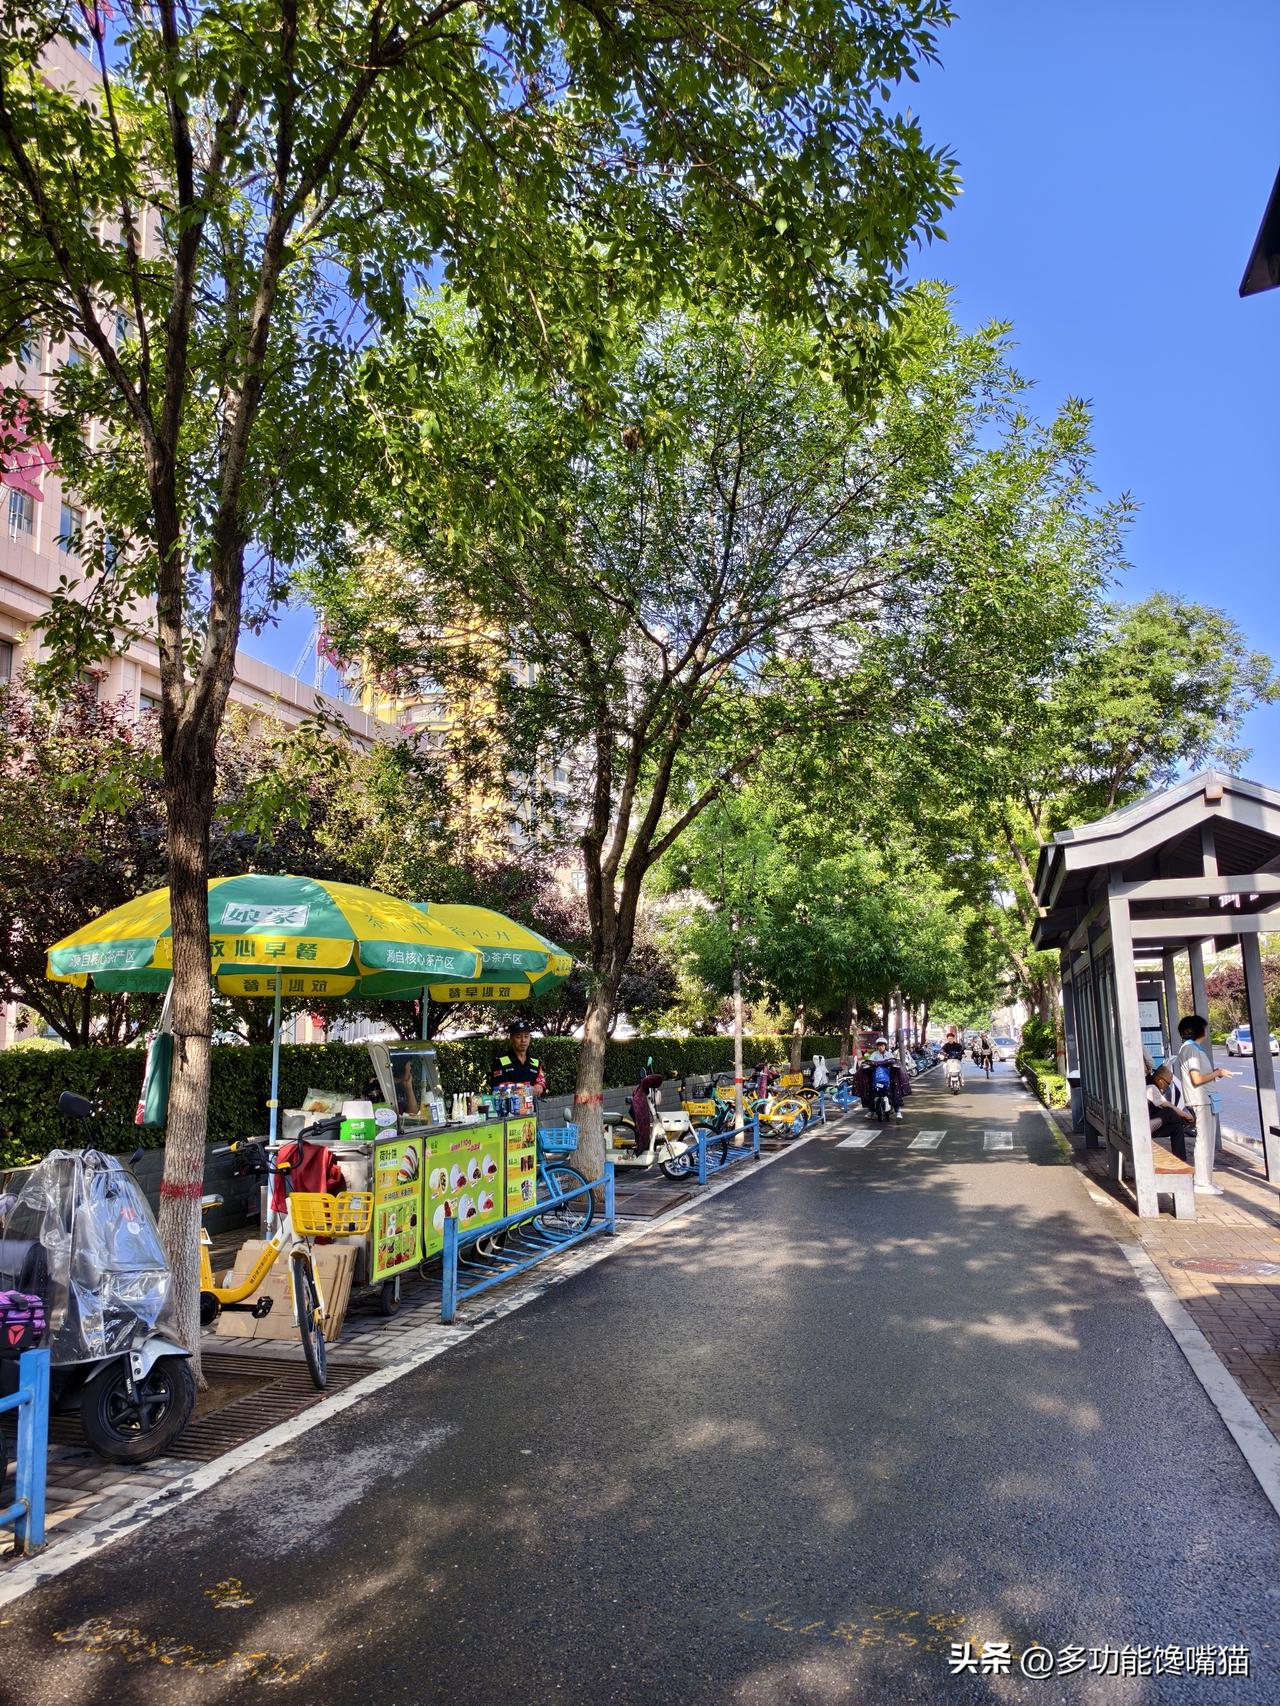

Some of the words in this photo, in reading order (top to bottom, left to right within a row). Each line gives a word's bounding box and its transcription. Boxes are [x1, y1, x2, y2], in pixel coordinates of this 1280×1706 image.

[210, 939, 318, 960] 放心早餐
[386, 949, 455, 969] 源自核心茶产区
